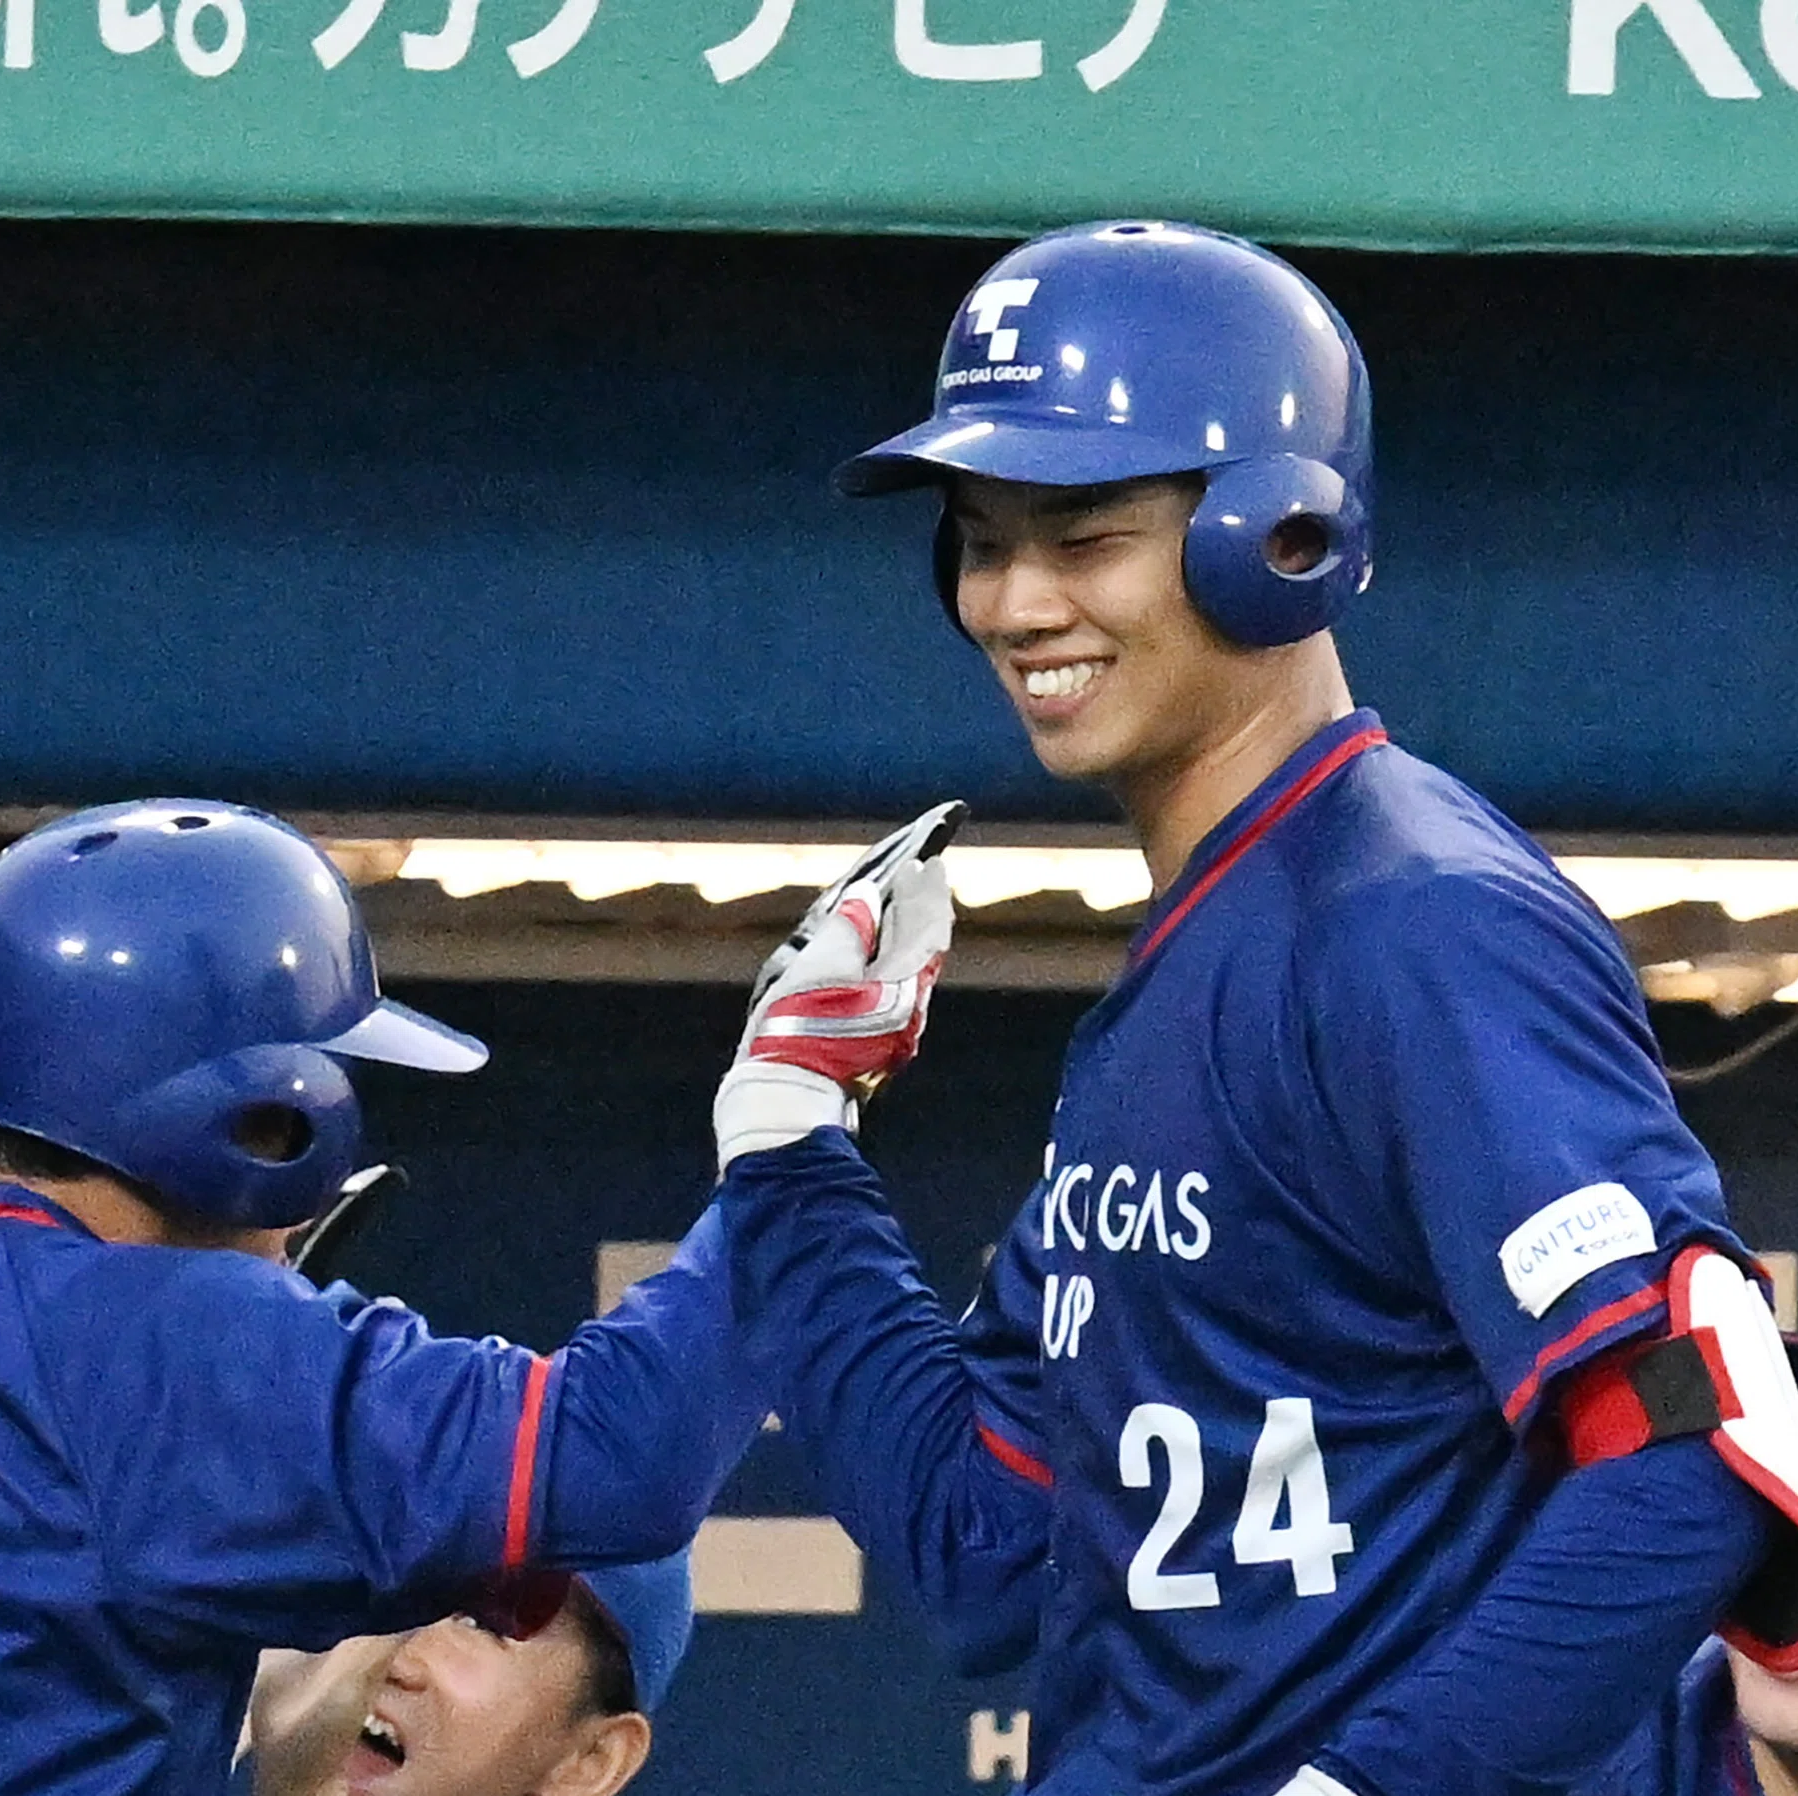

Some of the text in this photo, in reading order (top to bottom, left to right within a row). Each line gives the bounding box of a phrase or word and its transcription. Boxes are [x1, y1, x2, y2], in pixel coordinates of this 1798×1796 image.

[993, 365, 1043, 382] GROUP
[1097, 1164, 1211, 1261] GAS
[1511, 1199, 1630, 1283] IGNITURE
[1118, 1397, 1355, 1612] 24
